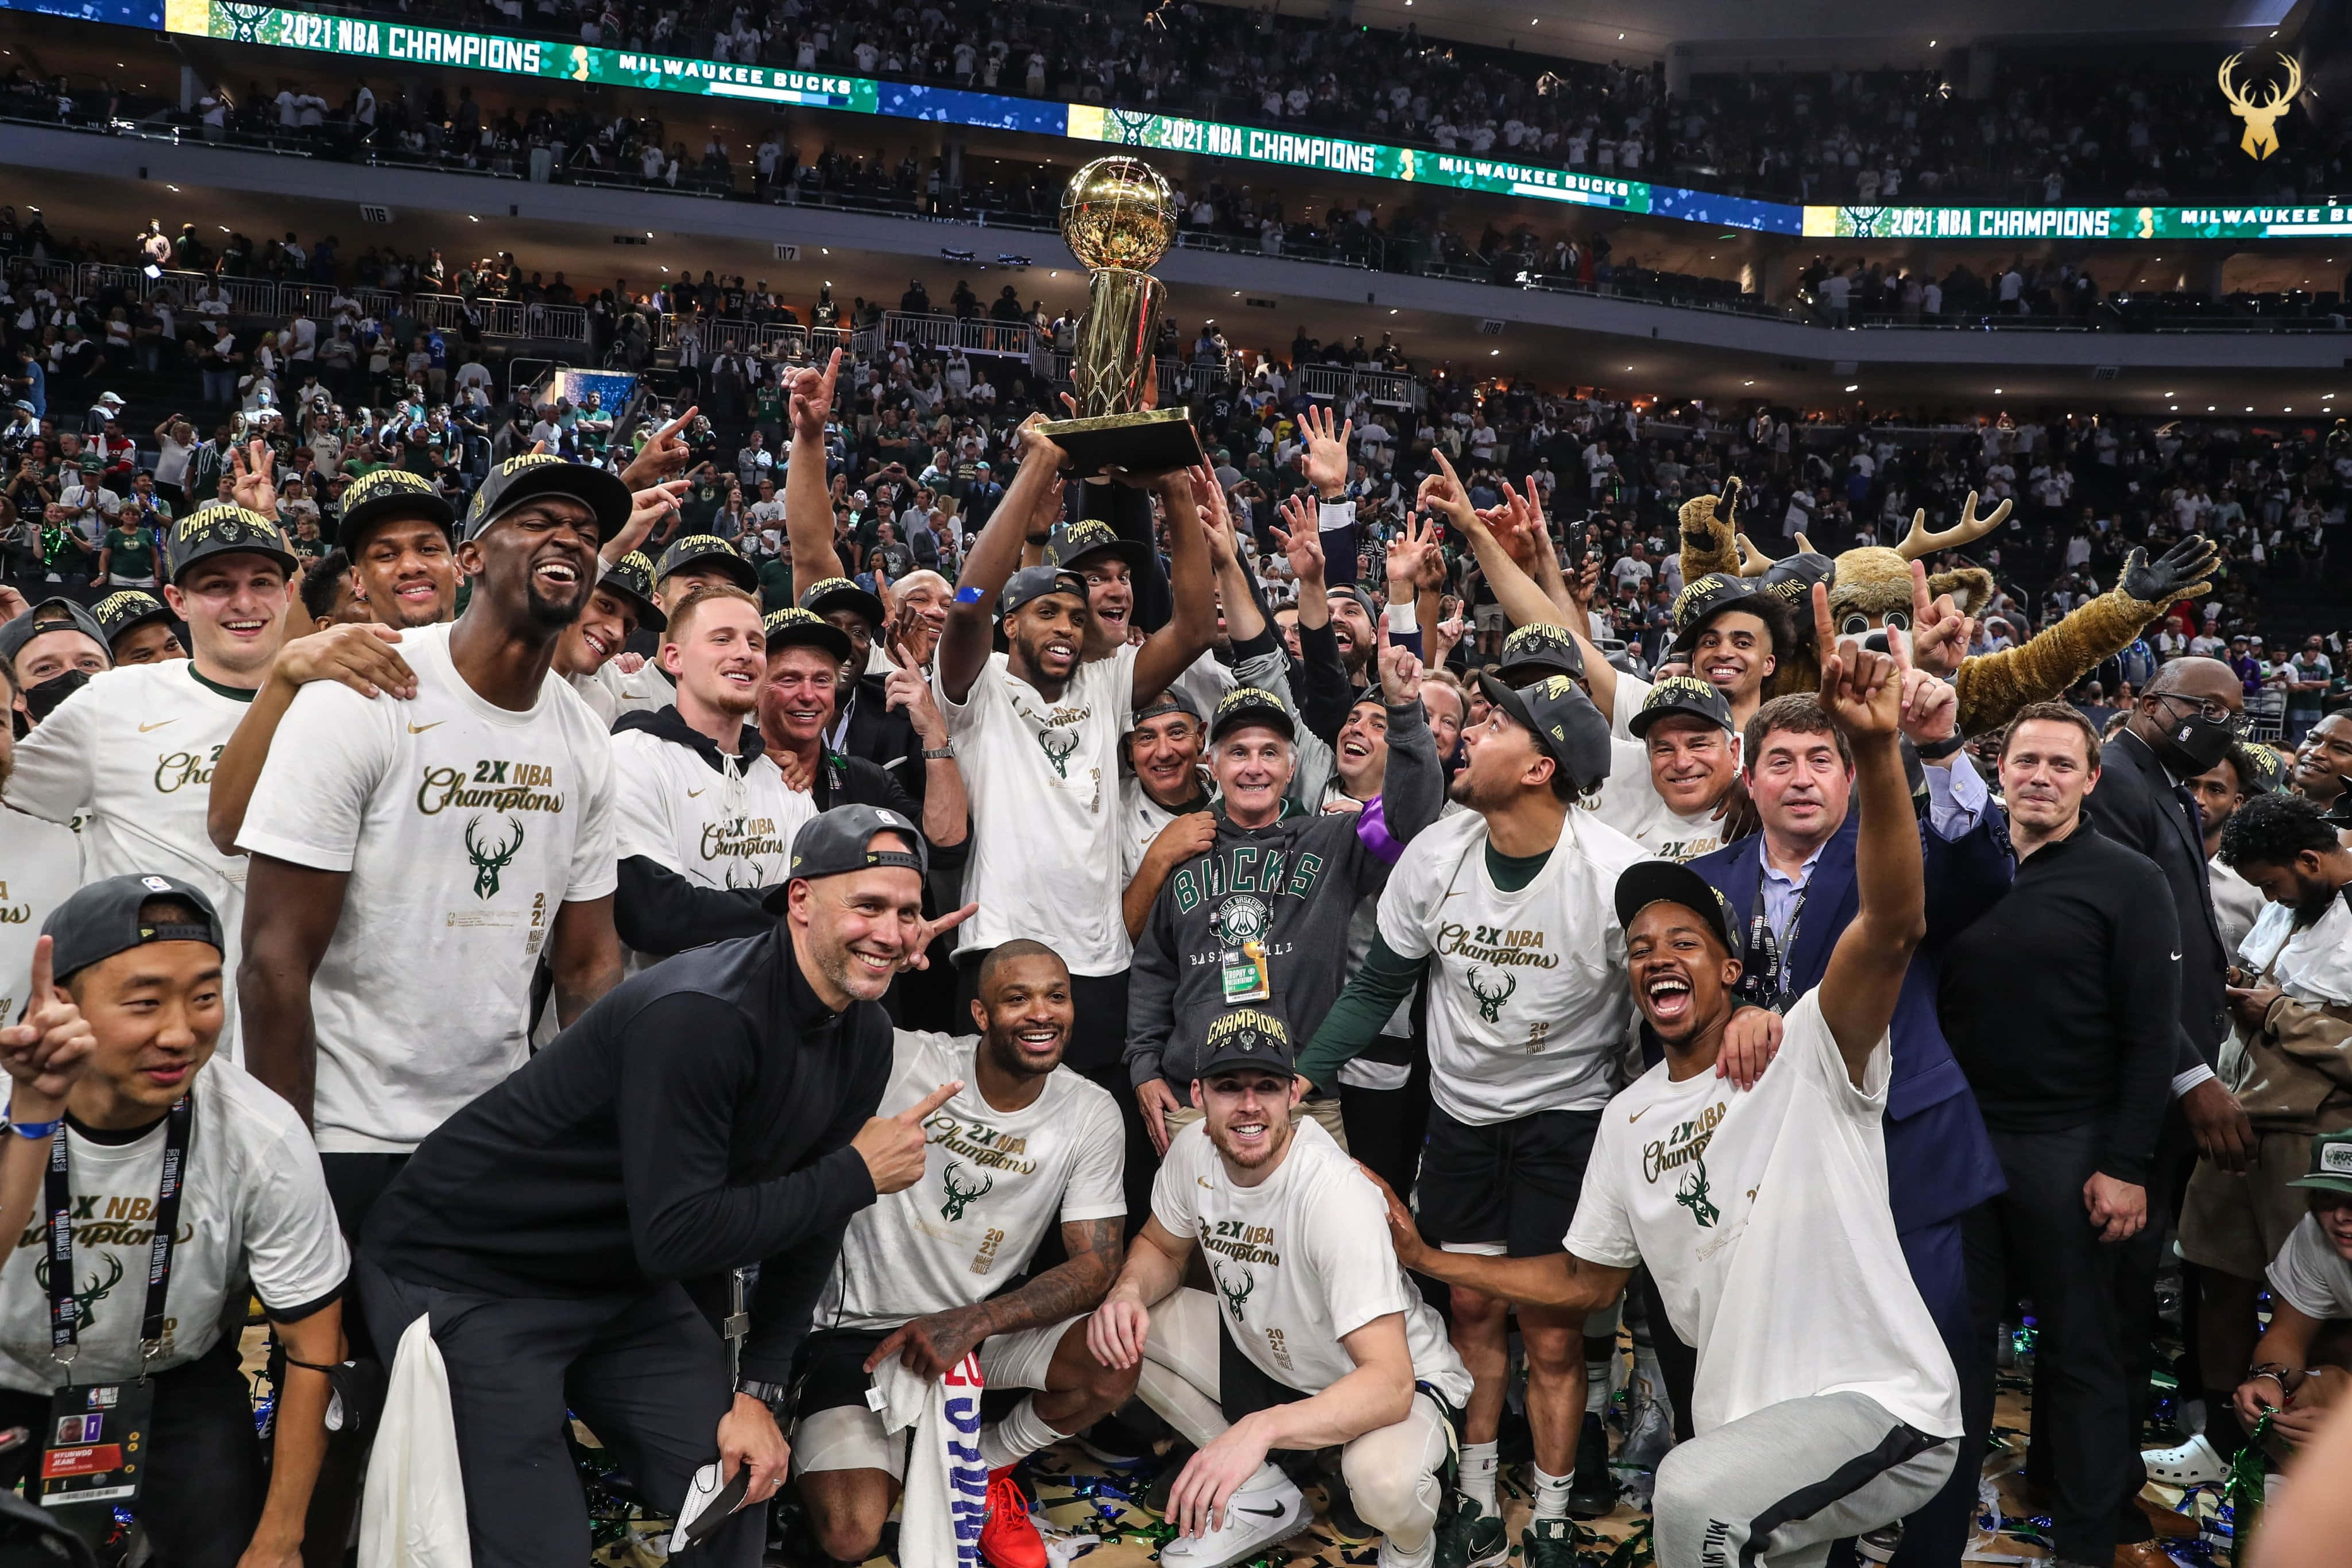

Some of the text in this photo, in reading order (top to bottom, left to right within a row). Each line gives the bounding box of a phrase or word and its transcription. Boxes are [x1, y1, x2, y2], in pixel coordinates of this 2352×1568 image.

[281, 13, 541, 73] 2021 NBA CHAMPIONS
[620, 55, 851, 95] MILWAUKEE BUCKS
[1162, 119, 1375, 174] 2021 NBA CHAMPIONS
[1438, 157, 1629, 196] MILWAUKEE BUCKS
[364, 207, 386, 222] 116
[1892, 210, 2109, 236] 2021 NBA CHAMPIONS
[2181, 210, 2320, 223] MILWAUKEE
[777, 246, 795, 260] 117
[1483, 322, 1502, 335] 118
[1215, 405, 1228, 417] 34
[343, 469, 432, 513] CHAMPIONS
[179, 505, 277, 542] CHAMPIONS
[198, 529, 210, 542] 20
[618, 566, 630, 574] 20
[1704, 594, 1714, 602] 21
[1504, 622, 1570, 652] CHAMPIONS
[1512, 640, 1557, 652] 20 21
[473, 760, 553, 787] 2X NBA
[417, 766, 565, 816] Champions
[748, 818, 776, 836] NBA
[700, 822, 784, 861] Champions
[1658, 841, 1686, 858] 2X
[1174, 847, 1323, 915] BUCKS
[1227, 935, 1243, 945] EST.
[1437, 920, 1560, 970] Champions
[1474, 925, 1544, 948] 2X NBA
[1225, 968, 1246, 979] TROPHY
[1226, 977, 1254, 986] PRESENTATION
[1206, 1012, 1287, 1046] CHAMPIONS
[1530, 1022, 1550, 1033] 20
[1220, 1036, 1275, 1048] 20 21
[1526, 1043, 1546, 1056] FINALS
[922, 1110, 1037, 1175] Champions
[966, 1124, 999, 1146] 2X
[1669, 1120, 1696, 1147] 2X
[52, 1140, 67, 1164] FINALS
[161, 1149, 180, 1193] NBA FINALS 2021
[55, 1214, 71, 1260] NBA FINALS 2021
[984, 1228, 1005, 1243] 20
[1216, 1221, 1274, 1246] 2X NBA
[150, 1234, 169, 1279] NBA FINALS 2021
[969, 1263, 990, 1276] FINALS
[59, 1302, 74, 1317] NBA
[1265, 1327, 1285, 1340] 20
[98, 1394, 118, 1404] FINALS
[99, 1387, 112, 1396] NBA
[1702, 1518, 1730, 1568] MILW
